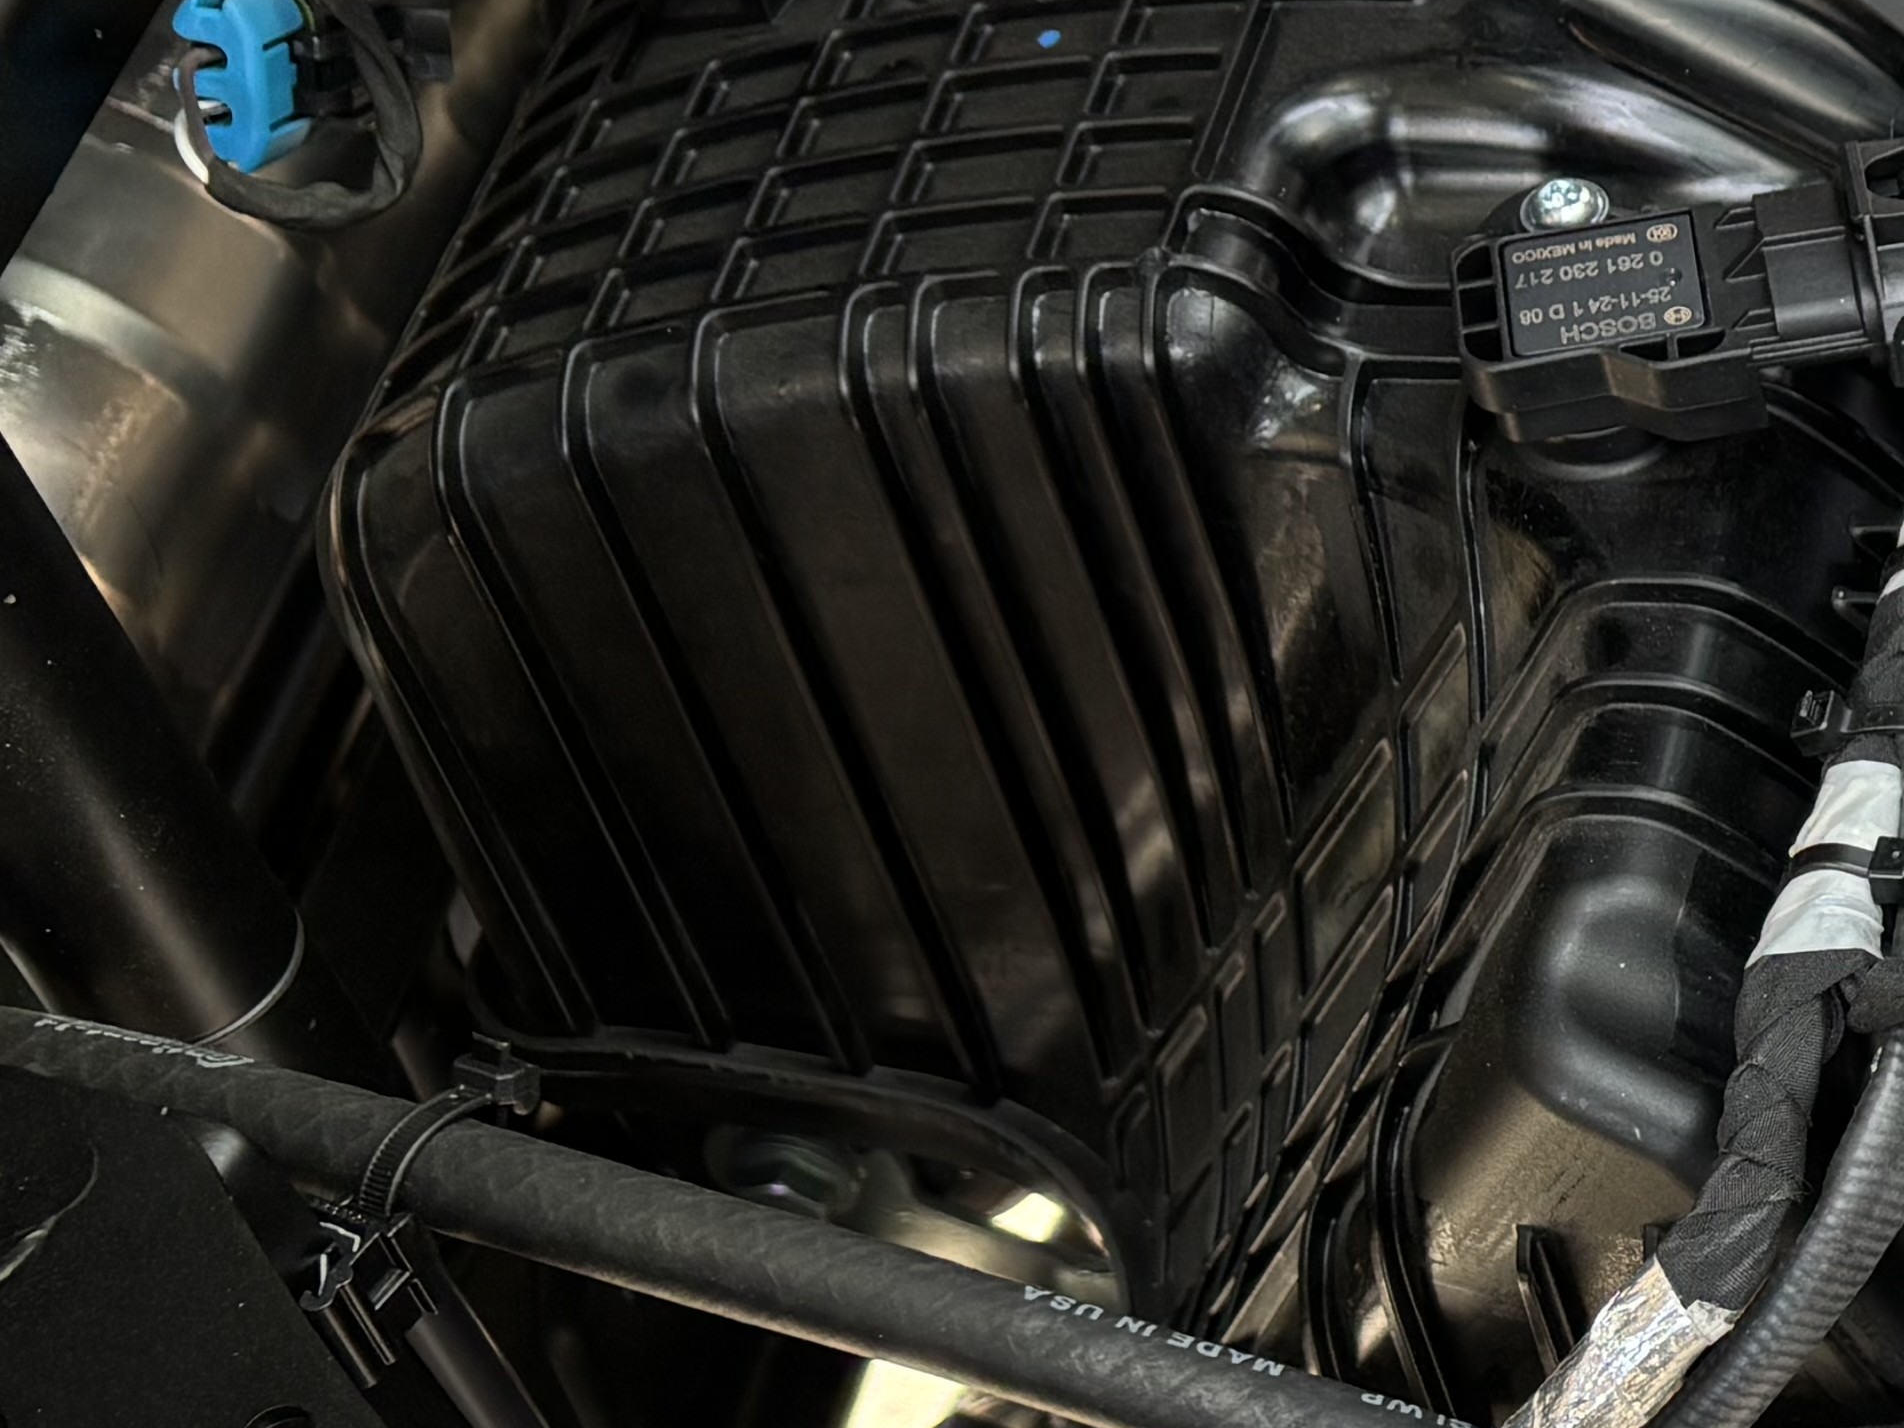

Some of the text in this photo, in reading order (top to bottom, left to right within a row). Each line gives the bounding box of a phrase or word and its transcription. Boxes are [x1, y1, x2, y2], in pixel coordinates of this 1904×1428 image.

[1580, 238, 1593, 251] in
[1597, 232, 1636, 248] Made
[1512, 241, 1576, 264] MEXICO
[1515, 250, 1663, 288] 0 261 230 217
[1572, 300, 1583, 316] 1
[1588, 287, 1671, 313] 25-11-24
[1550, 304, 1564, 321] D
[1560, 313, 1655, 345] BOSCH
[1023, 1284, 1286, 1378] MADE IN USA
